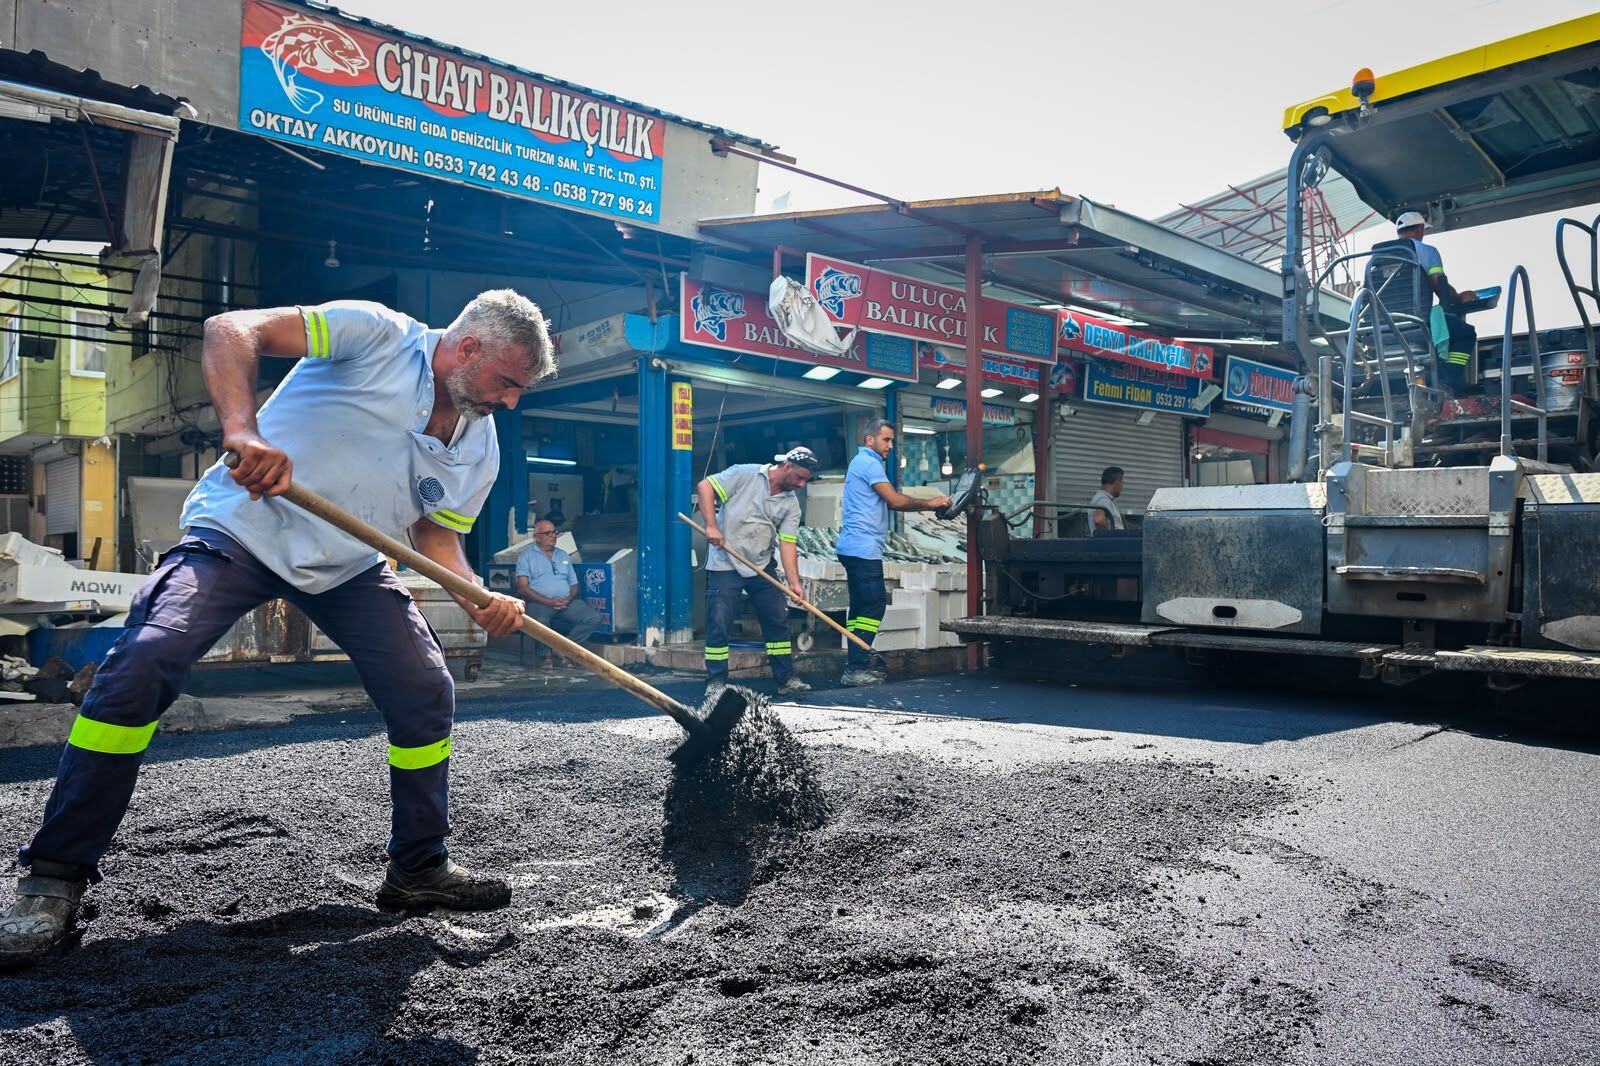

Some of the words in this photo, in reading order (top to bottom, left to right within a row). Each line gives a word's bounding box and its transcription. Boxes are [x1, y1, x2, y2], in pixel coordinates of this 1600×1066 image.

[488, 73, 654, 160] BALIKÇILIK
[251, 109, 318, 140] OKTAY
[323, 126, 419, 164] AKKOYUN:
[424, 150, 464, 175] 0533
[468, 159, 497, 182] 742
[500, 168, 519, 187] 43
[523, 174, 541, 192] 48
[553, 181, 587, 201] 0538
[591, 189, 615, 208] 727
[618, 196, 634, 213] 96
[637, 201, 654, 217] 24
[333, 98, 350, 115] SU
[355, 101, 417, 132] ÜRÜNLERİ
[420, 121, 448, 140] GIDA
[451, 129, 513, 155] DENİZCİLİK
[515, 145, 555, 166] TURİZM
[557, 155, 580, 172] SAN.
[583, 162, 596, 176] VE
[598, 164, 616, 180] TİC.
[618, 173, 638, 186] LTD.
[639, 176, 656, 191] ŞTİ.
[890, 280, 967, 315] ULUÇA
[866, 300, 999, 344] BALIKÇIK
[1084, 322, 1126, 355] DERYA
[1156, 392, 1172, 407] 0532
[70, 580, 122, 595] MOWI
